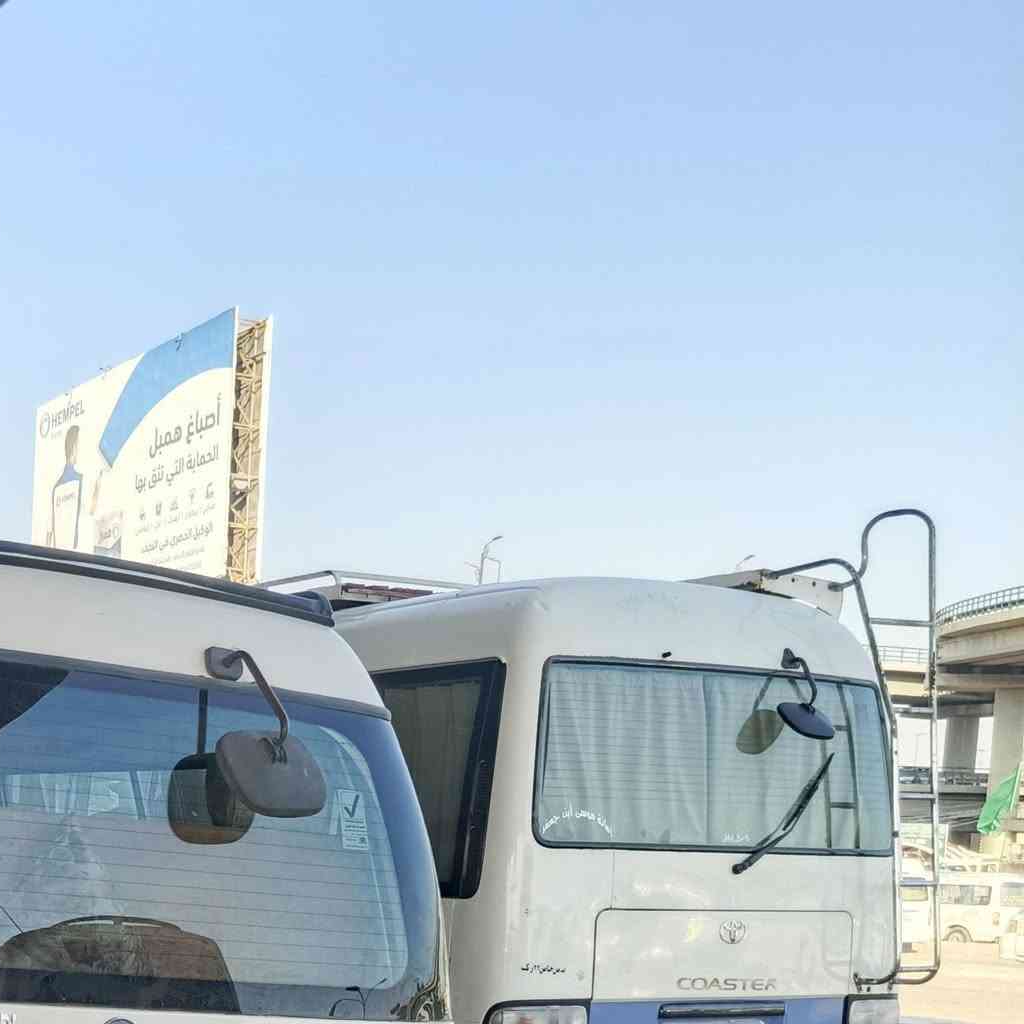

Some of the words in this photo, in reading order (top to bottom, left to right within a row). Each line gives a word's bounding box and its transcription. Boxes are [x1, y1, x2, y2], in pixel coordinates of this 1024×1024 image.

[51, 400, 85, 428] HEMPEL
[185, 391, 221, 444] أصباغ
[149, 427, 182, 458] همبل
[166, 456, 184, 486] التي
[186, 444, 219, 473] الحماية
[148, 464, 164, 489] تثق
[676, 977, 777, 991] COASTER
